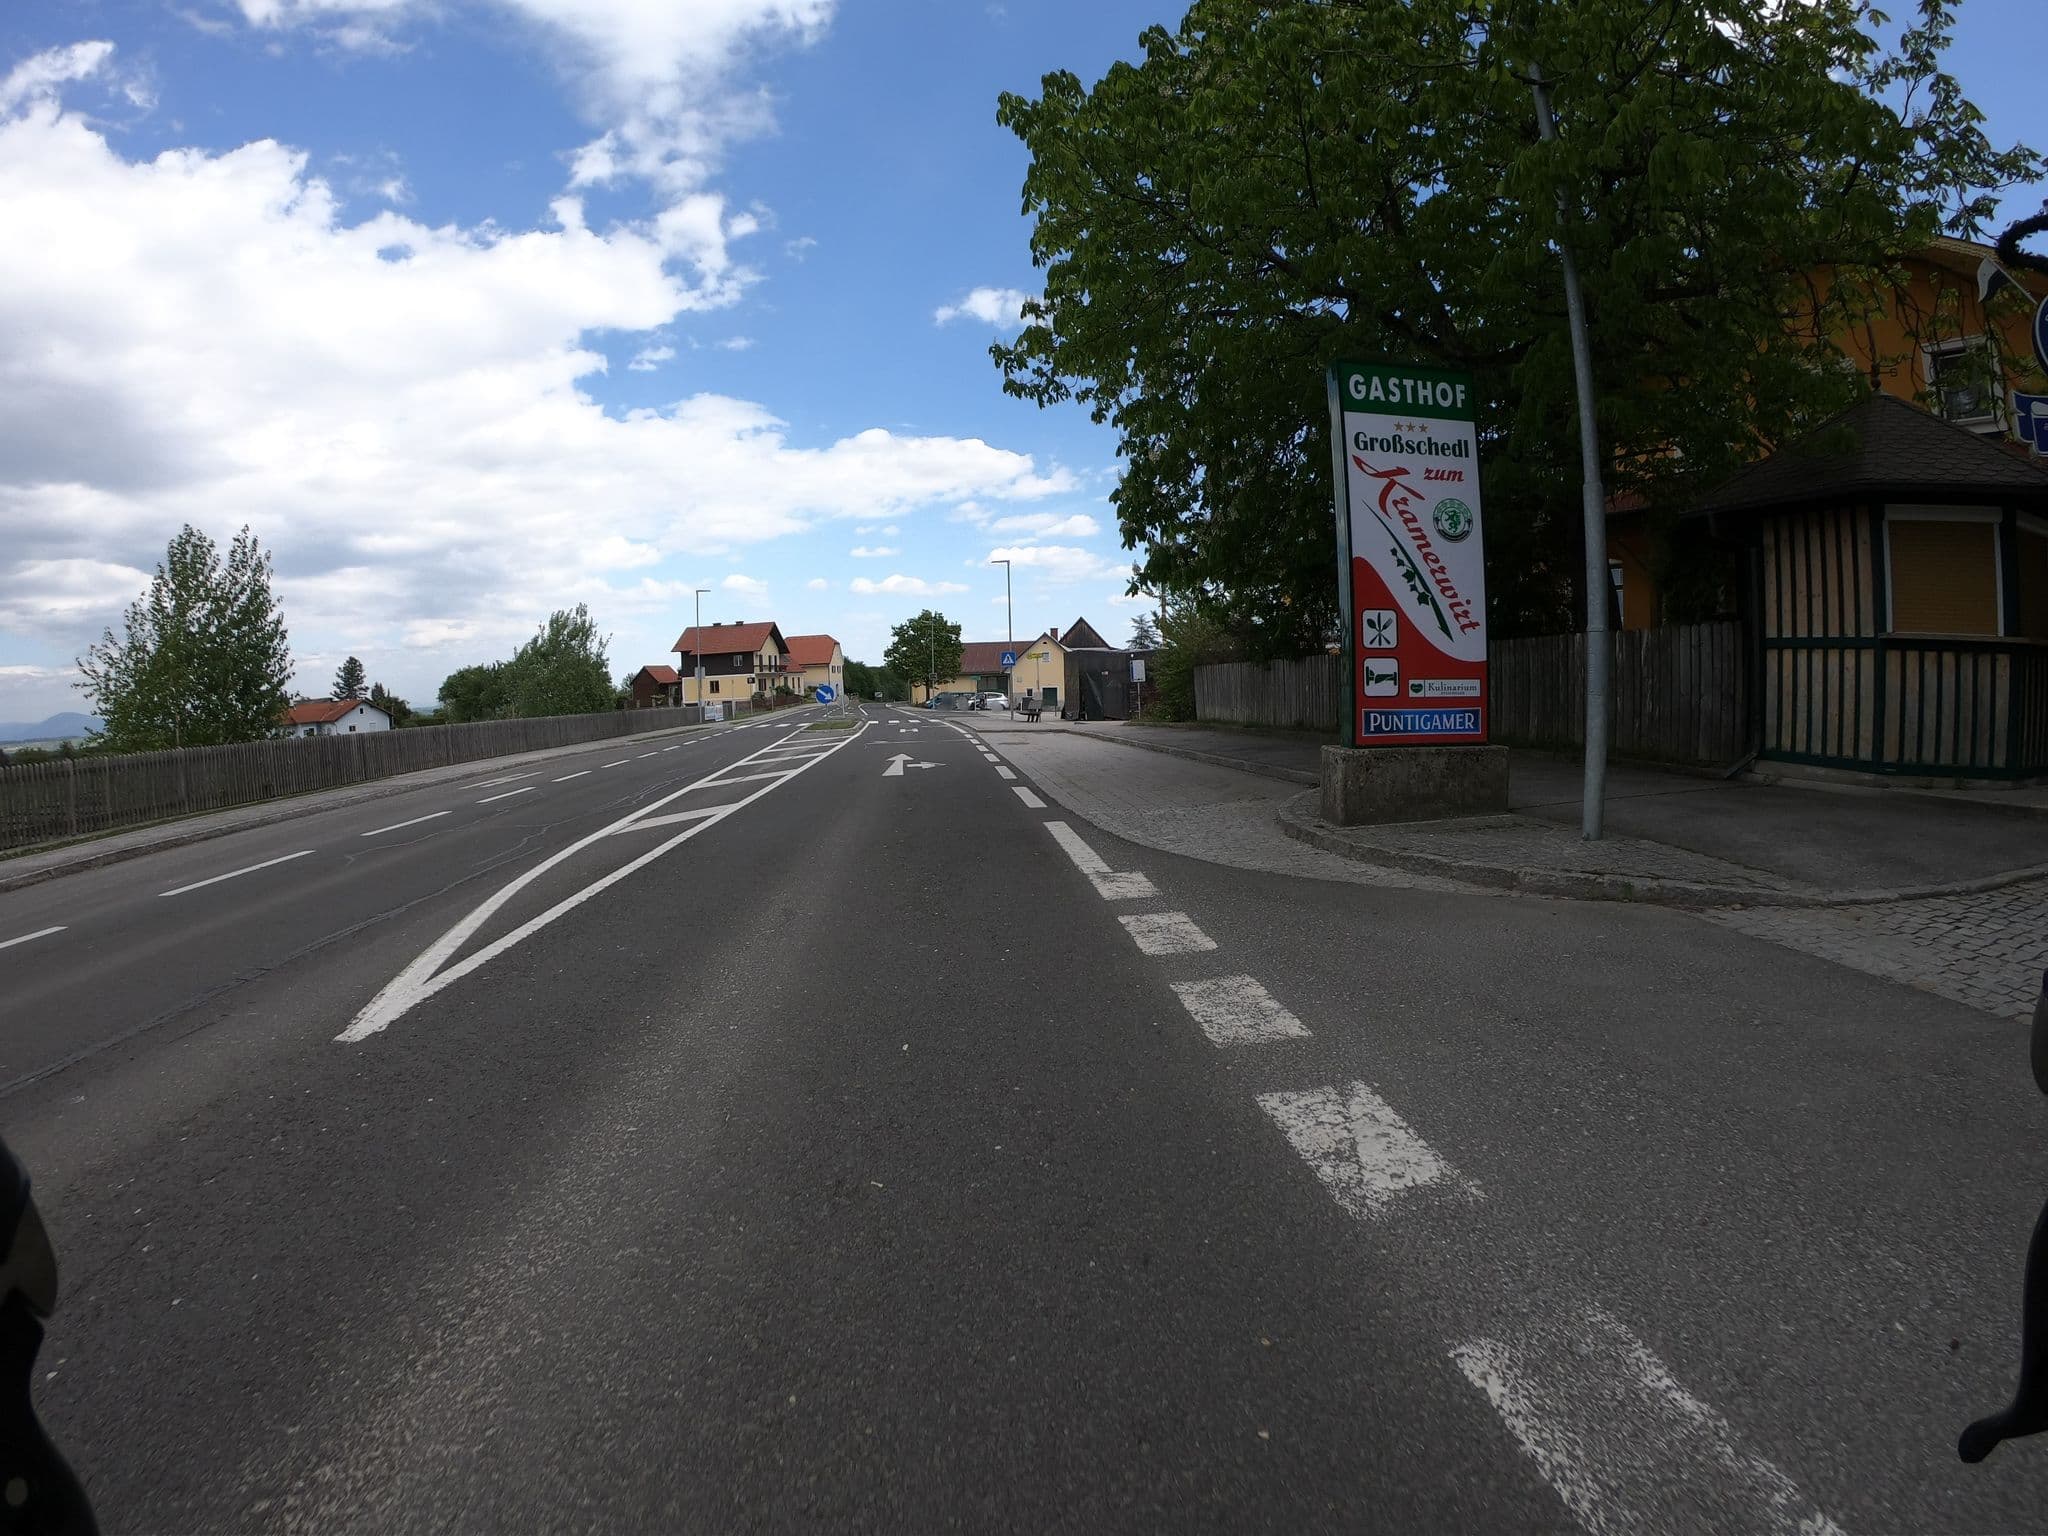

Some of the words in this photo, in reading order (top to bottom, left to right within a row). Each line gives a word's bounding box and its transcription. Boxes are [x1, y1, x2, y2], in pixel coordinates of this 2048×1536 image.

[1348, 373, 1466, 409] GASTHOF
[1353, 431, 1470, 458] Großschedl
[1423, 467, 1465, 483] zum
[1352, 454, 1481, 636] Kramerwirt
[1428, 682, 1478, 692] Kulinarium
[1369, 712, 1475, 732] PUNTIGAMER
